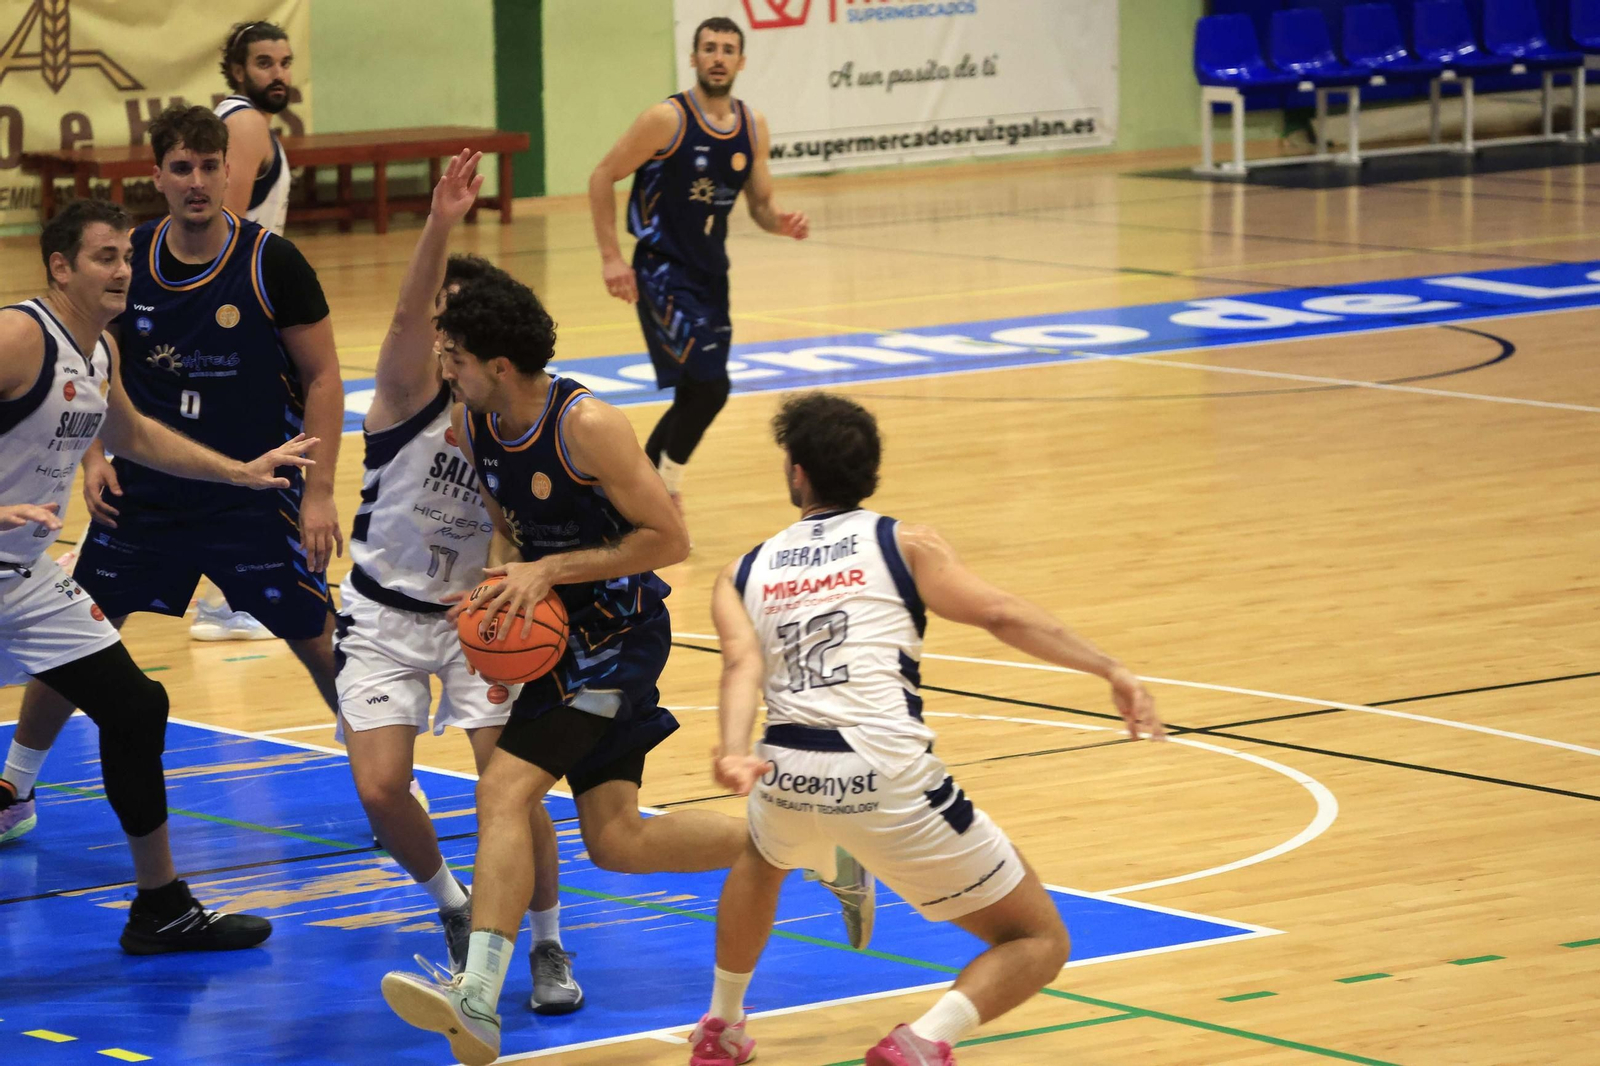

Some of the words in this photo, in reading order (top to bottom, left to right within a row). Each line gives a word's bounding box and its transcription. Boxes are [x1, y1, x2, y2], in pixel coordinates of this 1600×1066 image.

[845, 1, 977, 23] SUPERMERCADOS
[829, 60, 853, 90] A
[857, 71, 883, 87] un
[886, 59, 949, 94] pasito
[954, 53, 977, 79] de
[1169, 293, 1462, 330] de
[180, 389, 201, 419] 0
[434, 526, 475, 541] Resort
[426, 544, 459, 583] 17
[769, 534, 859, 570] LIBERATORE
[763, 569, 867, 602] MIRAMAR
[776, 609, 849, 694] 12
[366, 694, 390, 705] vive
[761, 759, 878, 804] Oceanyst
[775, 797, 815, 813] BEAUTY
[816, 801, 880, 815] TECHNOLOGY
